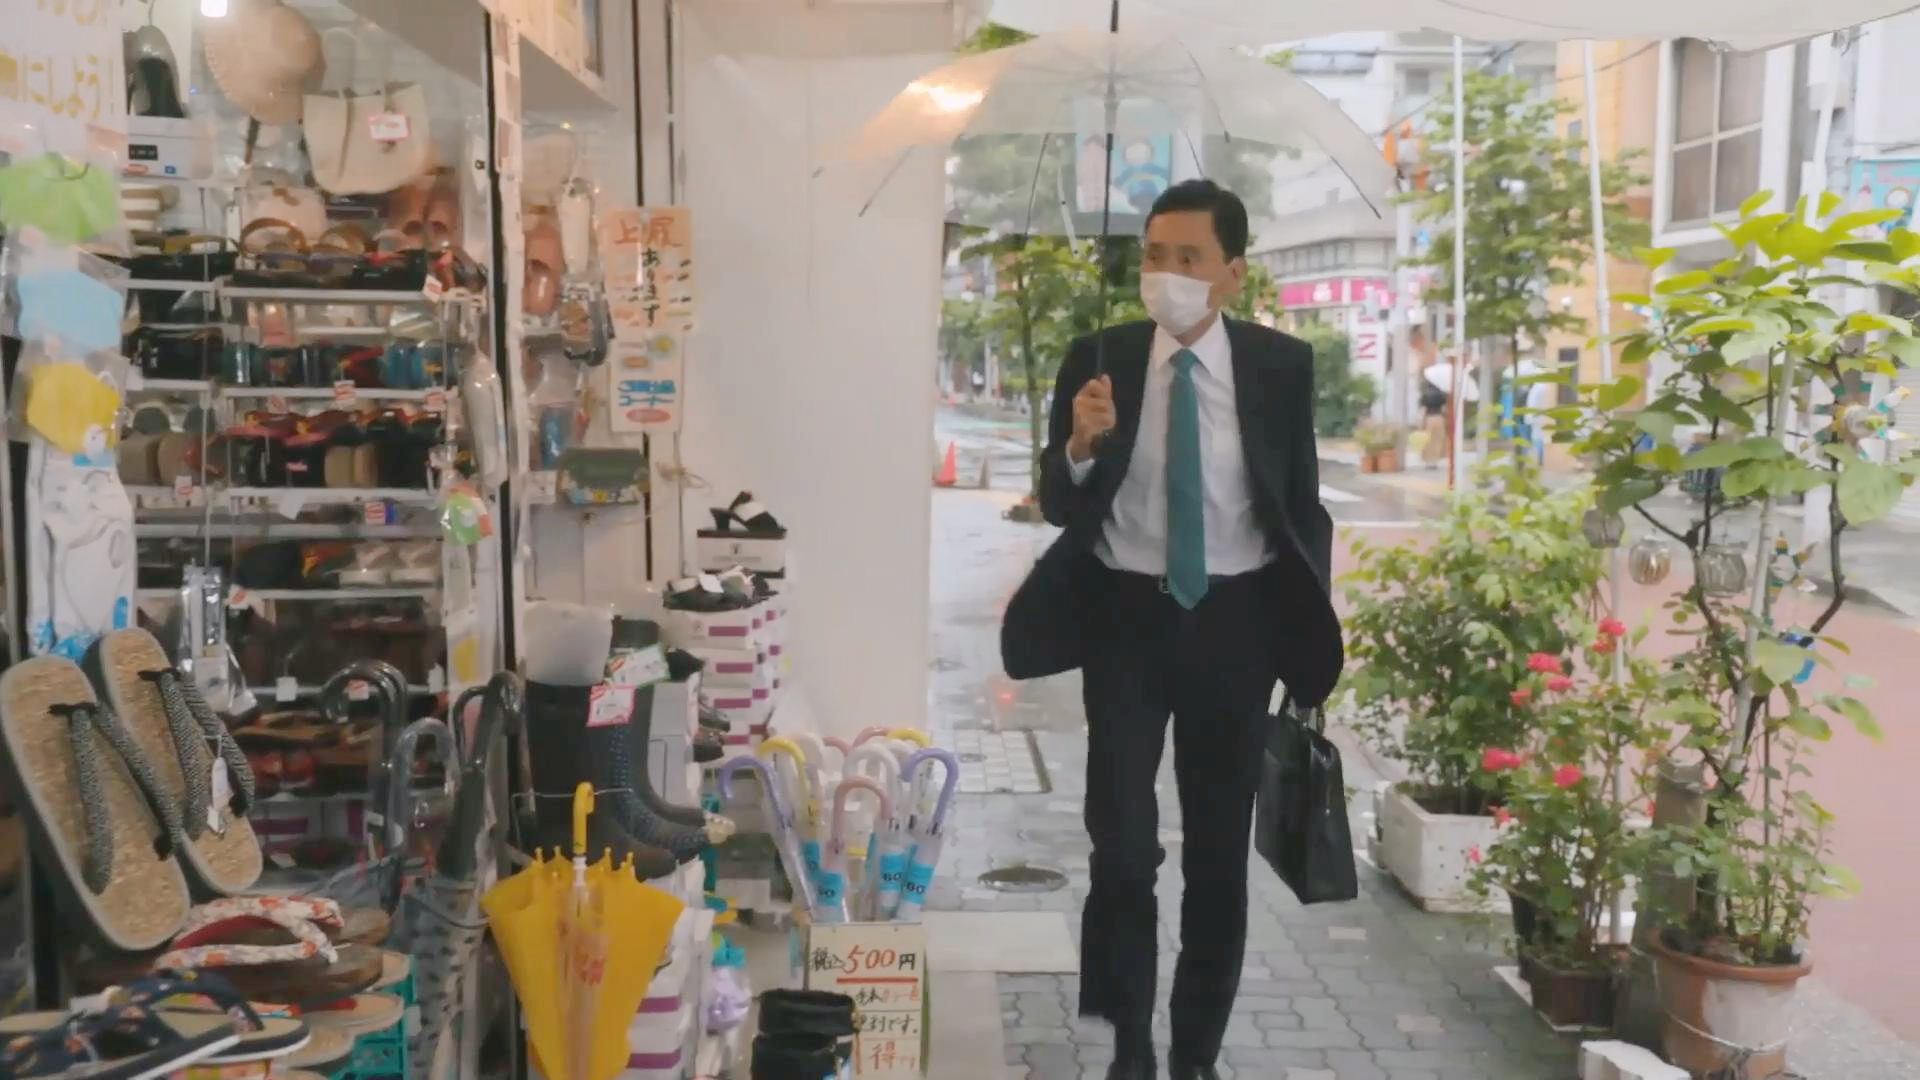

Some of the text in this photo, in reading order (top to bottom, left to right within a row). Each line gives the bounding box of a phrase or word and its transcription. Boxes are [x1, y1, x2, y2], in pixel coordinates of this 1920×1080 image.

[641, 246, 660, 328] あります
[811, 944, 917, 974] 税込500円
